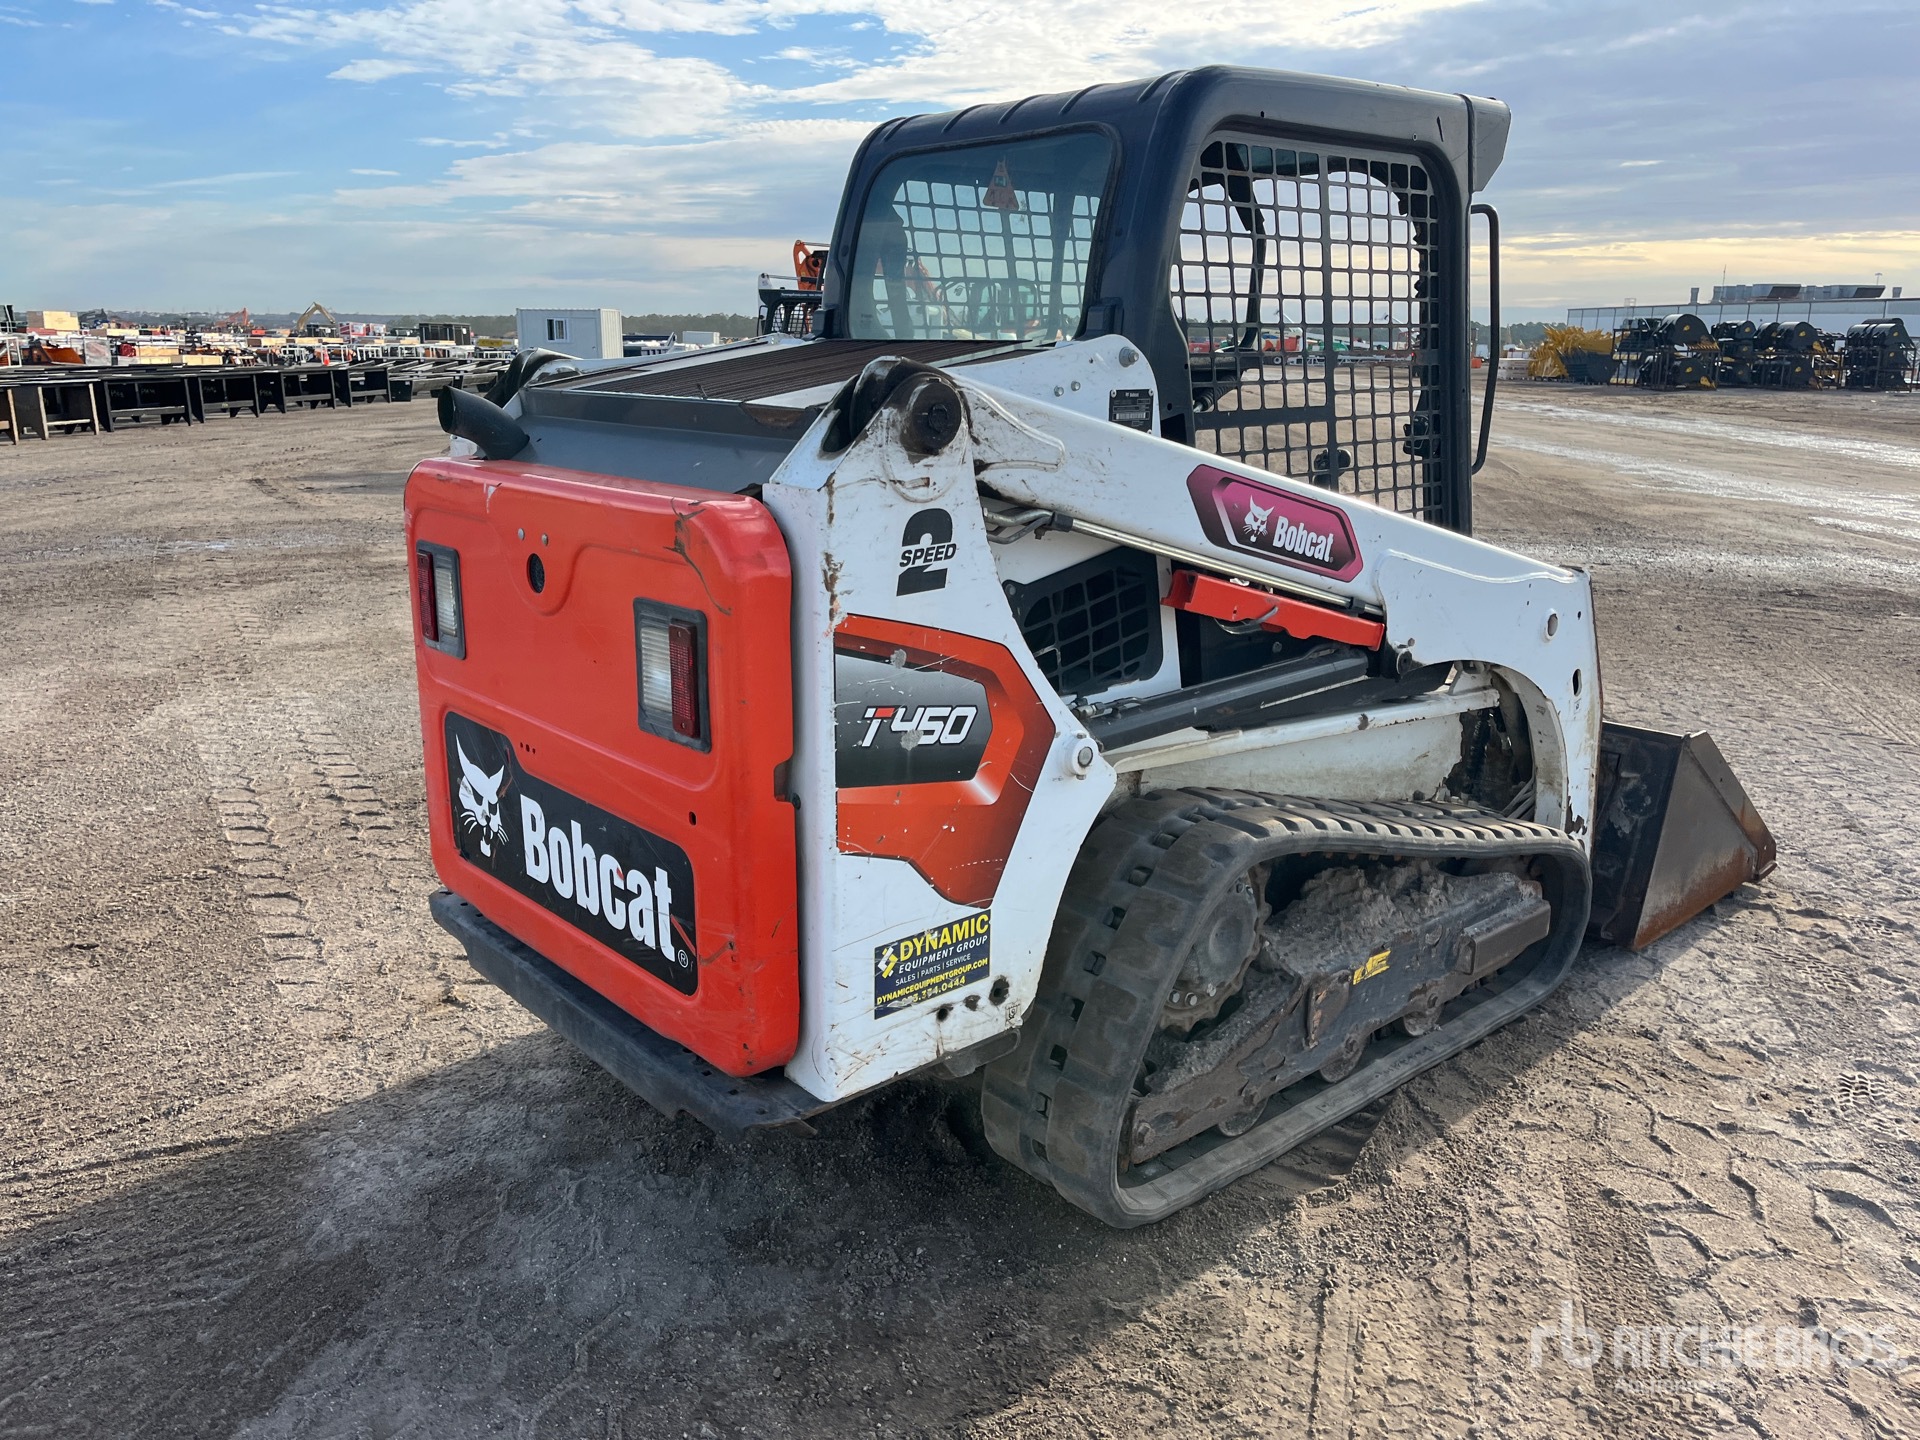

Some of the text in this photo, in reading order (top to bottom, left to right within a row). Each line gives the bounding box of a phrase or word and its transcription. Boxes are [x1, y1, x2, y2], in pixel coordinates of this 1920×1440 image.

[896, 507, 953, 597] 2
[899, 543, 957, 568] SPEED
[1273, 515, 1334, 563] Bobcat
[861, 705, 978, 748] T450
[519, 793, 676, 962] Bobcat
[898, 935, 988, 974] EQUIPMENT GROUP
[899, 914, 989, 962] DYNAMIC
[876, 957, 988, 1005] DYNAMICEQUIPMENTGROUP.COM
[895, 953, 971, 987] SALES PARTS SERVICE
